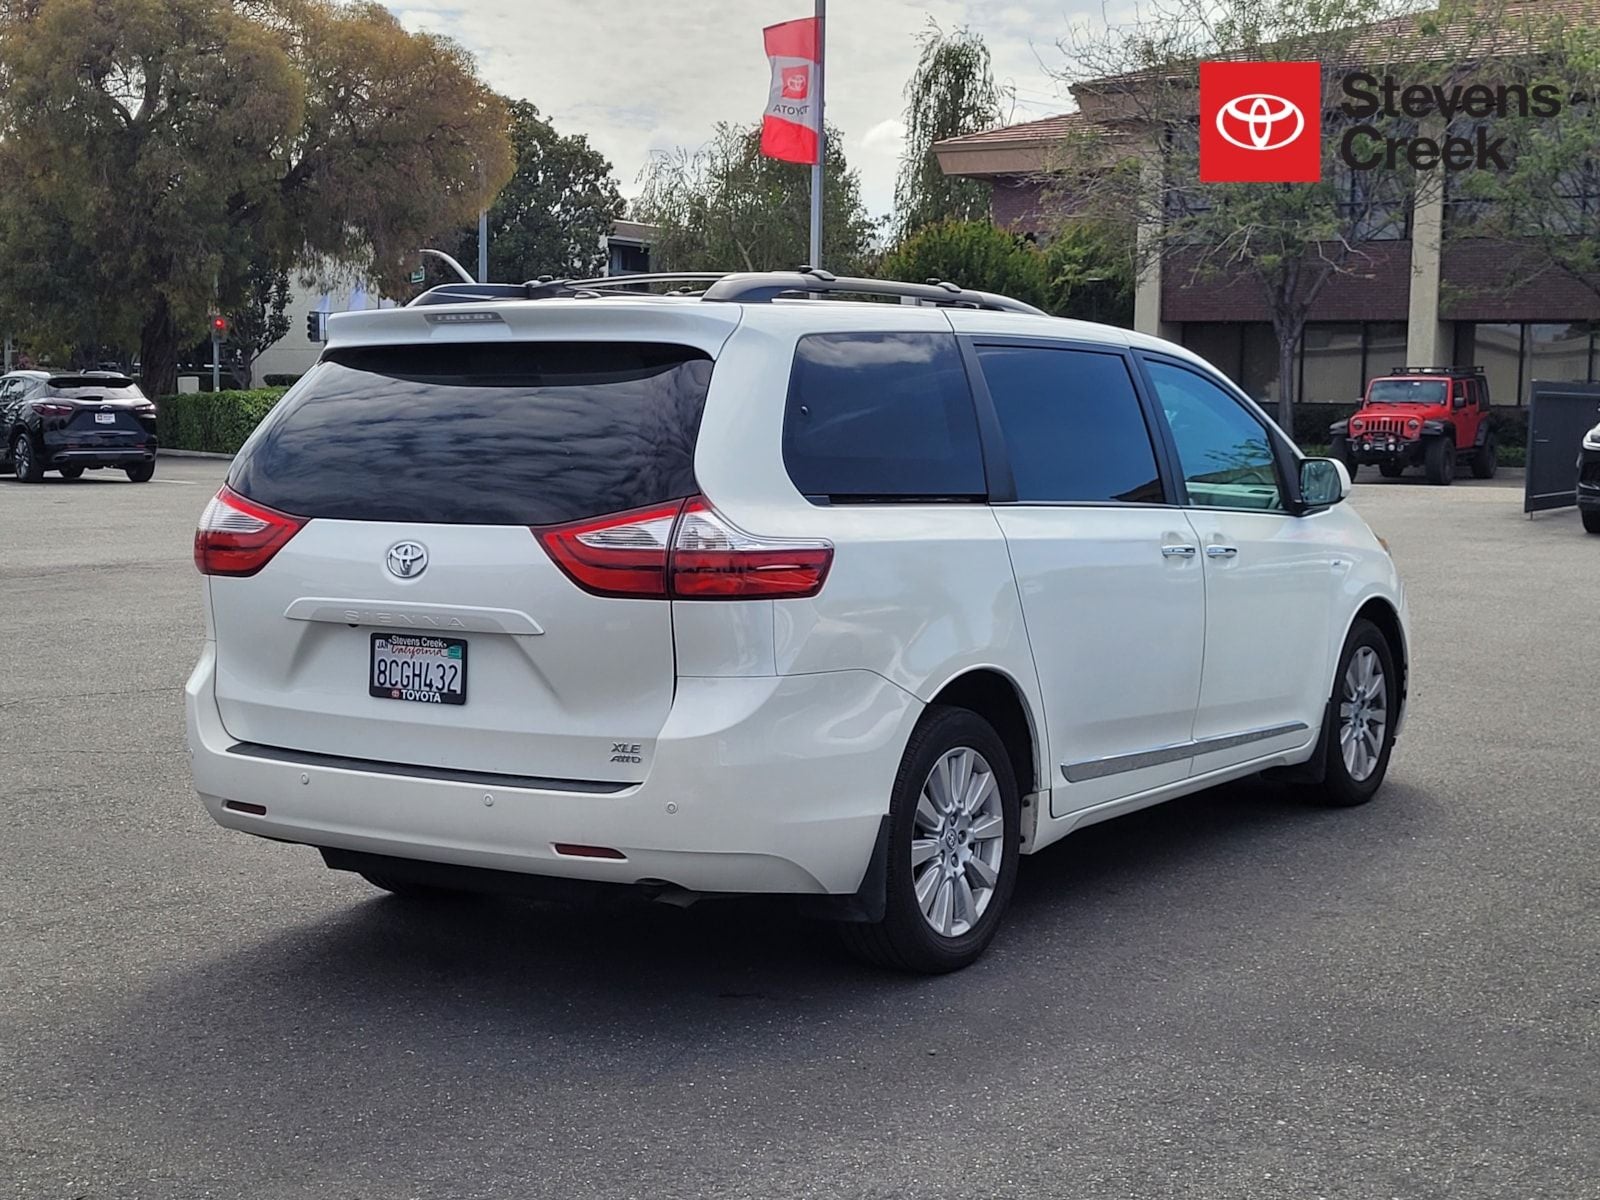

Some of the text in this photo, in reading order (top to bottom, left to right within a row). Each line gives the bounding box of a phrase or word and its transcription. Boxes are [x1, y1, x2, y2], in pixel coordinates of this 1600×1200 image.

[391, 635, 444, 648] Stevens Creek
[377, 658, 458, 693] 8CGH432
[401, 689, 441, 703] TOYOTA
[610, 742, 641, 753] XLE
